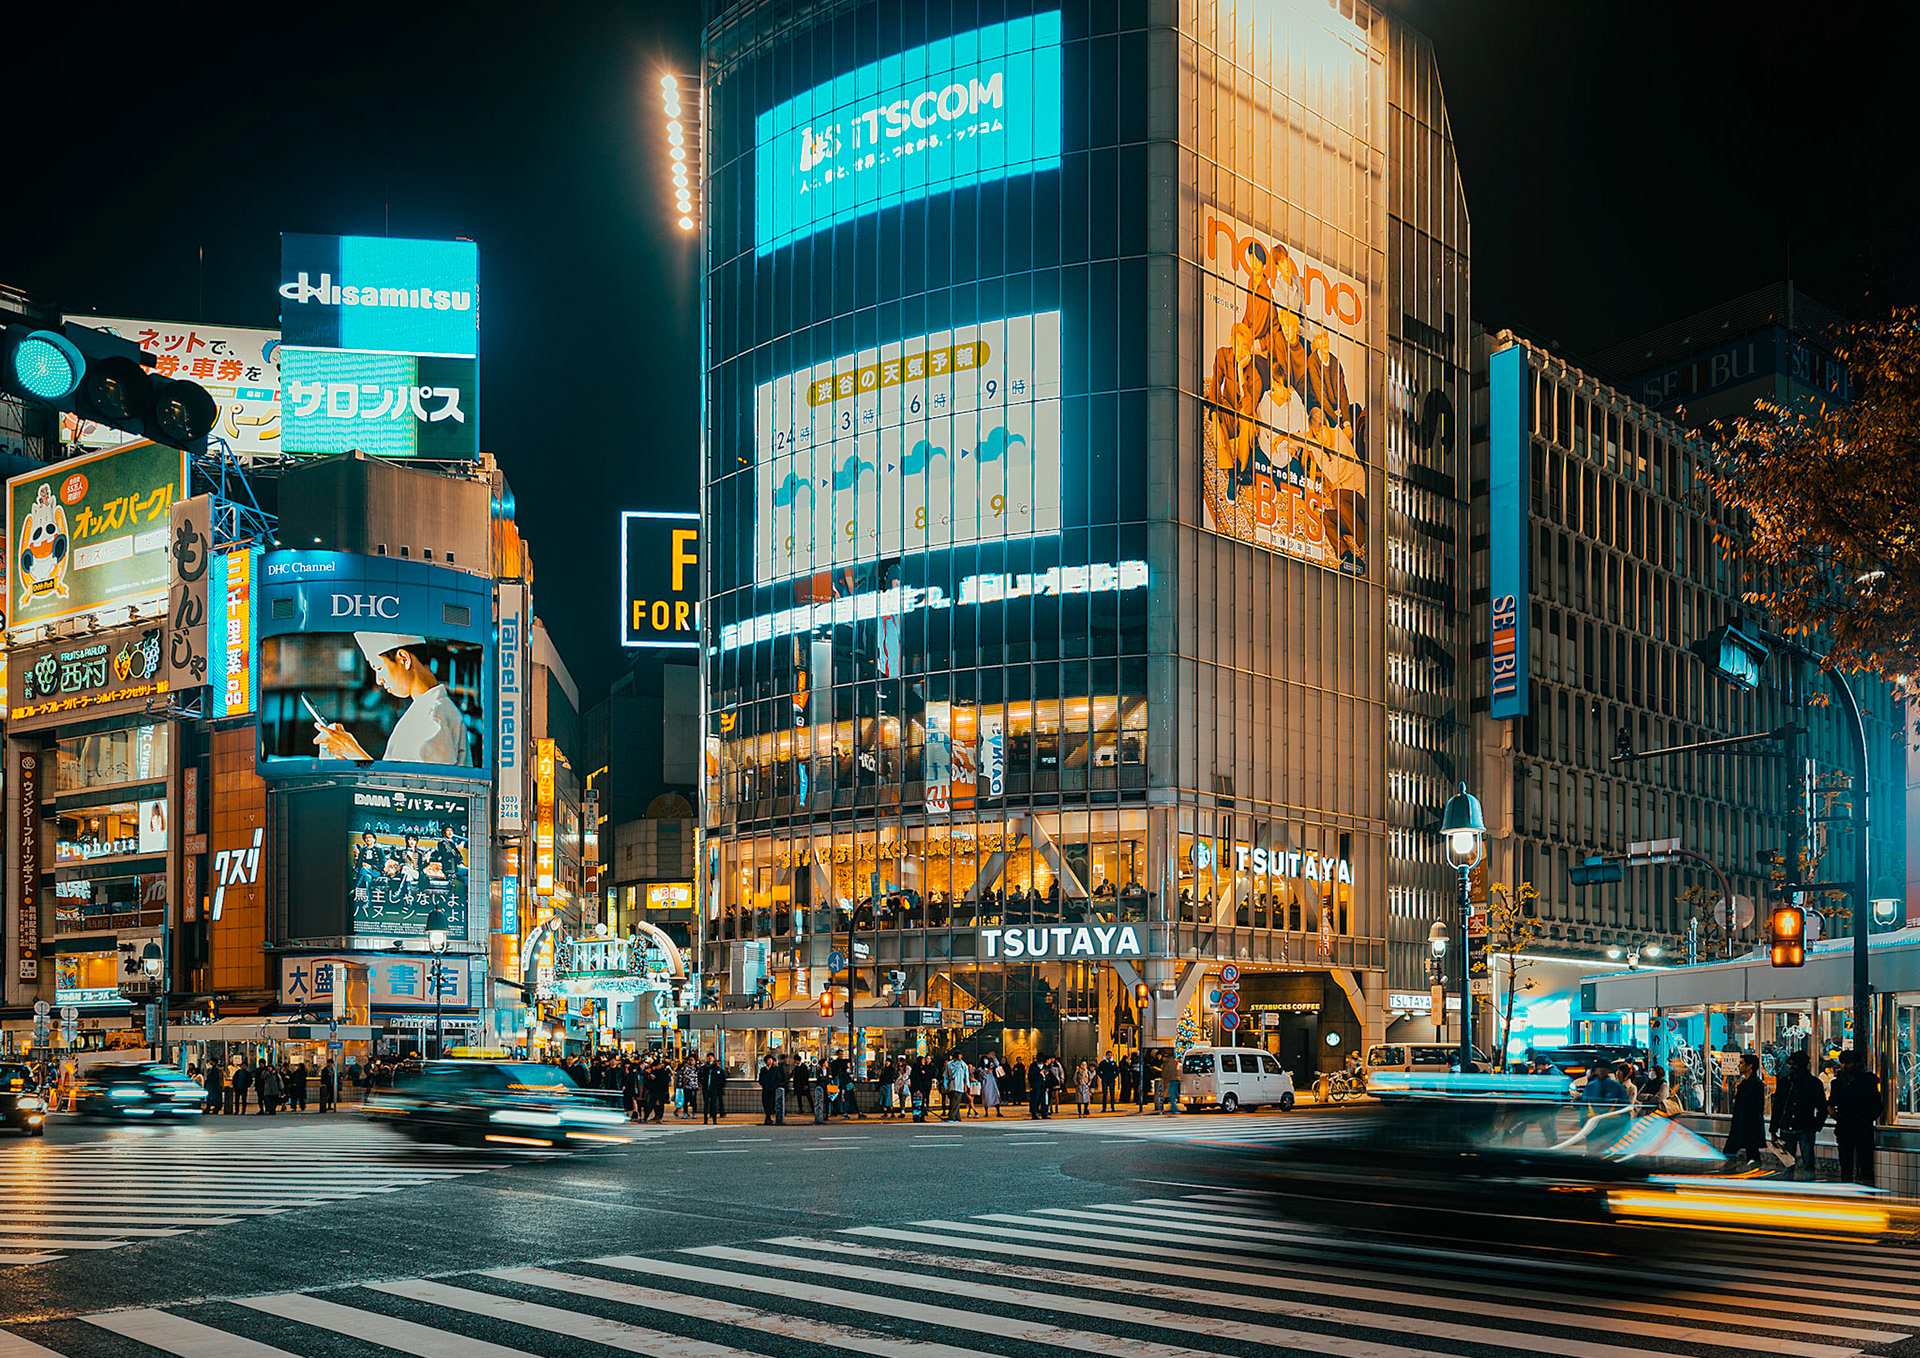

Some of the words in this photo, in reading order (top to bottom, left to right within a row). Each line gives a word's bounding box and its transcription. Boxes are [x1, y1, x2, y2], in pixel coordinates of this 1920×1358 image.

[279, 272, 471, 310] Hisamitsu
[139, 328, 235, 356] ネットで、
[139, 354, 262, 382] 券・車券を
[816, 346, 974, 402] 渋谷の天気予報
[1644, 342, 1756, 408] SEIBU
[288, 381, 465, 423] サロンパス
[986, 379, 998, 400] 9
[1012, 378, 1026, 395] 時
[910, 395, 921, 414] 6
[934, 393, 946, 408] 時
[841, 411, 851, 430] 3
[862, 408, 875, 425] 時
[776, 428, 795, 450] 24
[73, 482, 174, 541] オッズパーク!
[914, 505, 926, 530] 8
[991, 494, 1005, 519] 9
[1256, 473, 1325, 544] BTS
[268, 563, 290, 576] DHC
[291, 561, 336, 574] Channel
[172, 518, 209, 683] もんじゃ
[331, 593, 400, 619] DHC
[225, 556, 243, 707] 三千里薬品
[1492, 594, 1517, 695] SEIBU
[501, 611, 520, 694] Taisei
[24, 670, 34, 699] 渋谷
[60, 656, 108, 693] 西村
[501, 701, 519, 769] neon
[502, 795, 518, 804] (03)
[541, 743, 553, 829] クスリのことなら
[354, 793, 391, 808] DMM
[407, 797, 465, 814] バヌーシー
[501, 803, 519, 812] 3719
[501, 811, 519, 819] 2468
[61, 836, 136, 859] Euphoria
[779, 838, 909, 869] STARBUCKS
[1235, 846, 1353, 885] TSUTAYA
[353, 887, 466, 908] 馬主じゃないよ、
[353, 903, 466, 923] バヌーシーよ!
[1470, 916, 1483, 932] 本
[981, 926, 1142, 957] TSUTAYA
[288, 963, 459, 997] 大盛書店
[1250, 1003, 1291, 1012] STARBUCKS
[1292, 1002, 1321, 1010] COFFEE
[1390, 995, 1431, 1008] TSUTAYA
